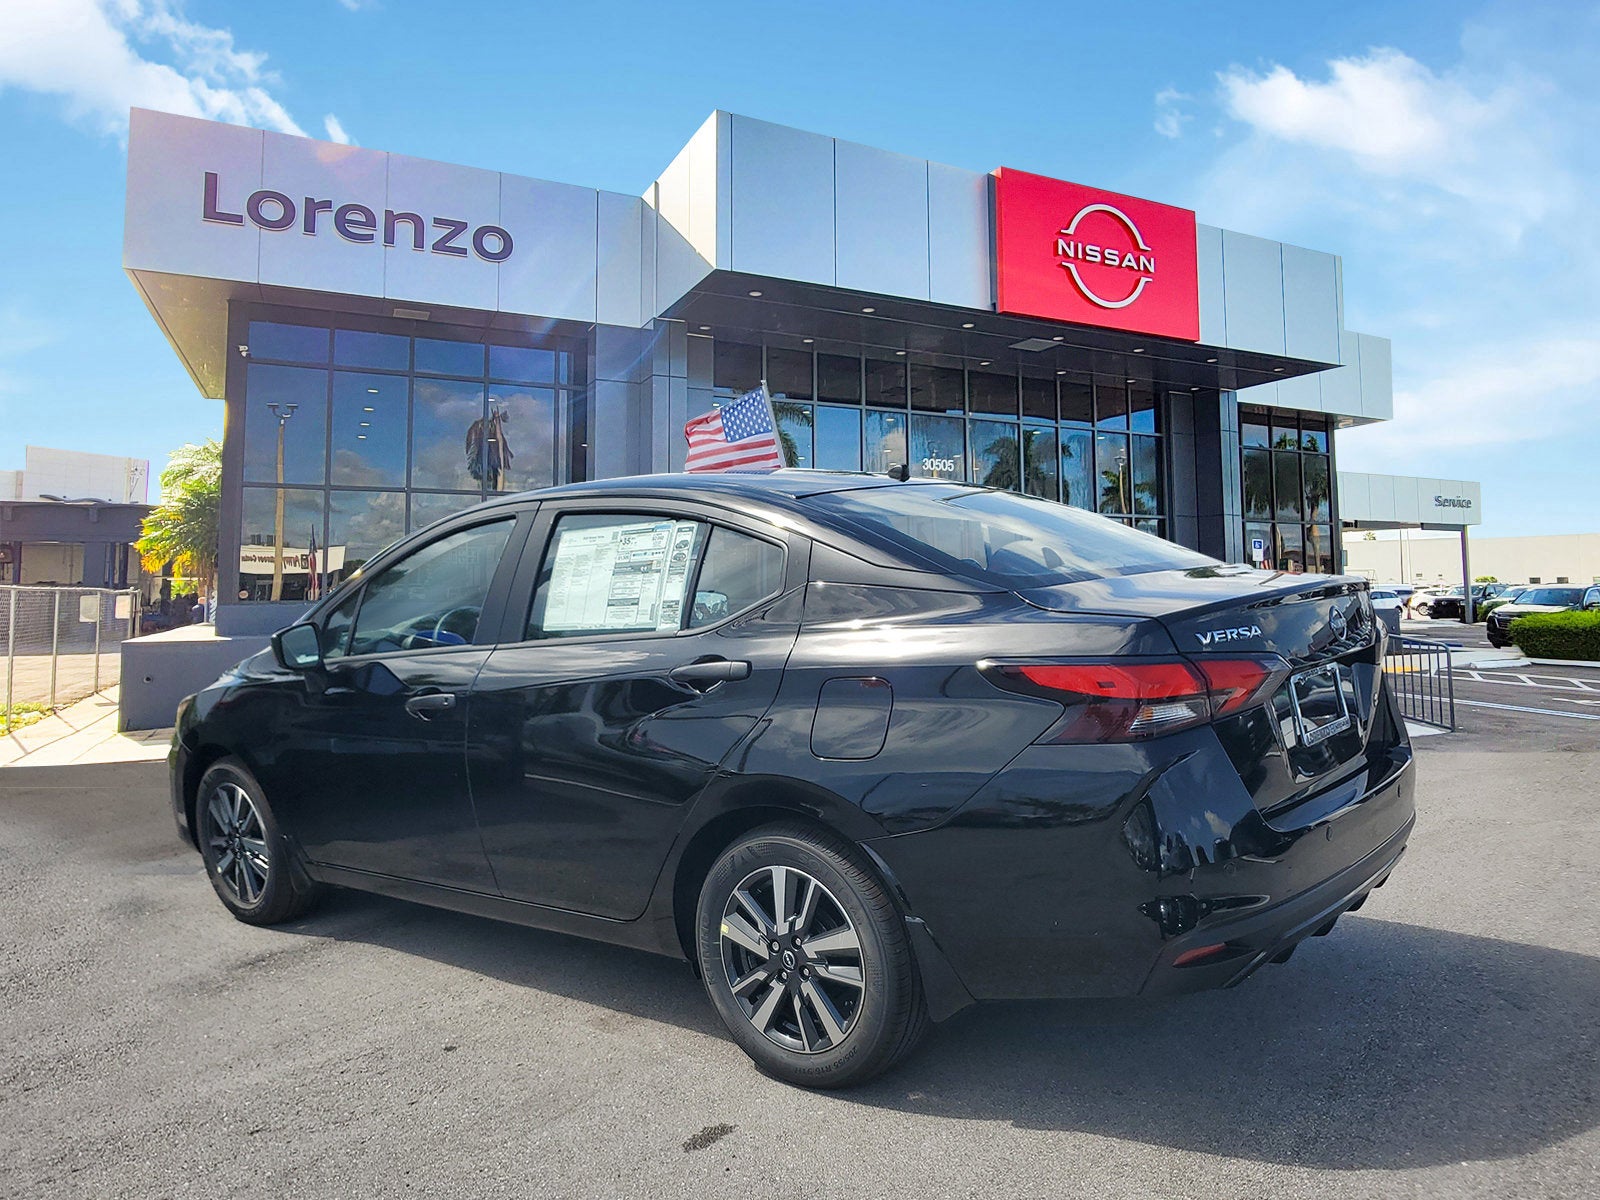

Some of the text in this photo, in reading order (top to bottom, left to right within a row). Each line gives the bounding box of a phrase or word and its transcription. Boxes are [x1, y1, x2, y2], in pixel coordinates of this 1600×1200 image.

[202, 171, 514, 263] Lorenzo
[1057, 238, 1155, 273] NISSAN
[922, 458, 955, 471] 30505
[1434, 495, 1472, 509] Service
[1195, 625, 1262, 645] VERSA
